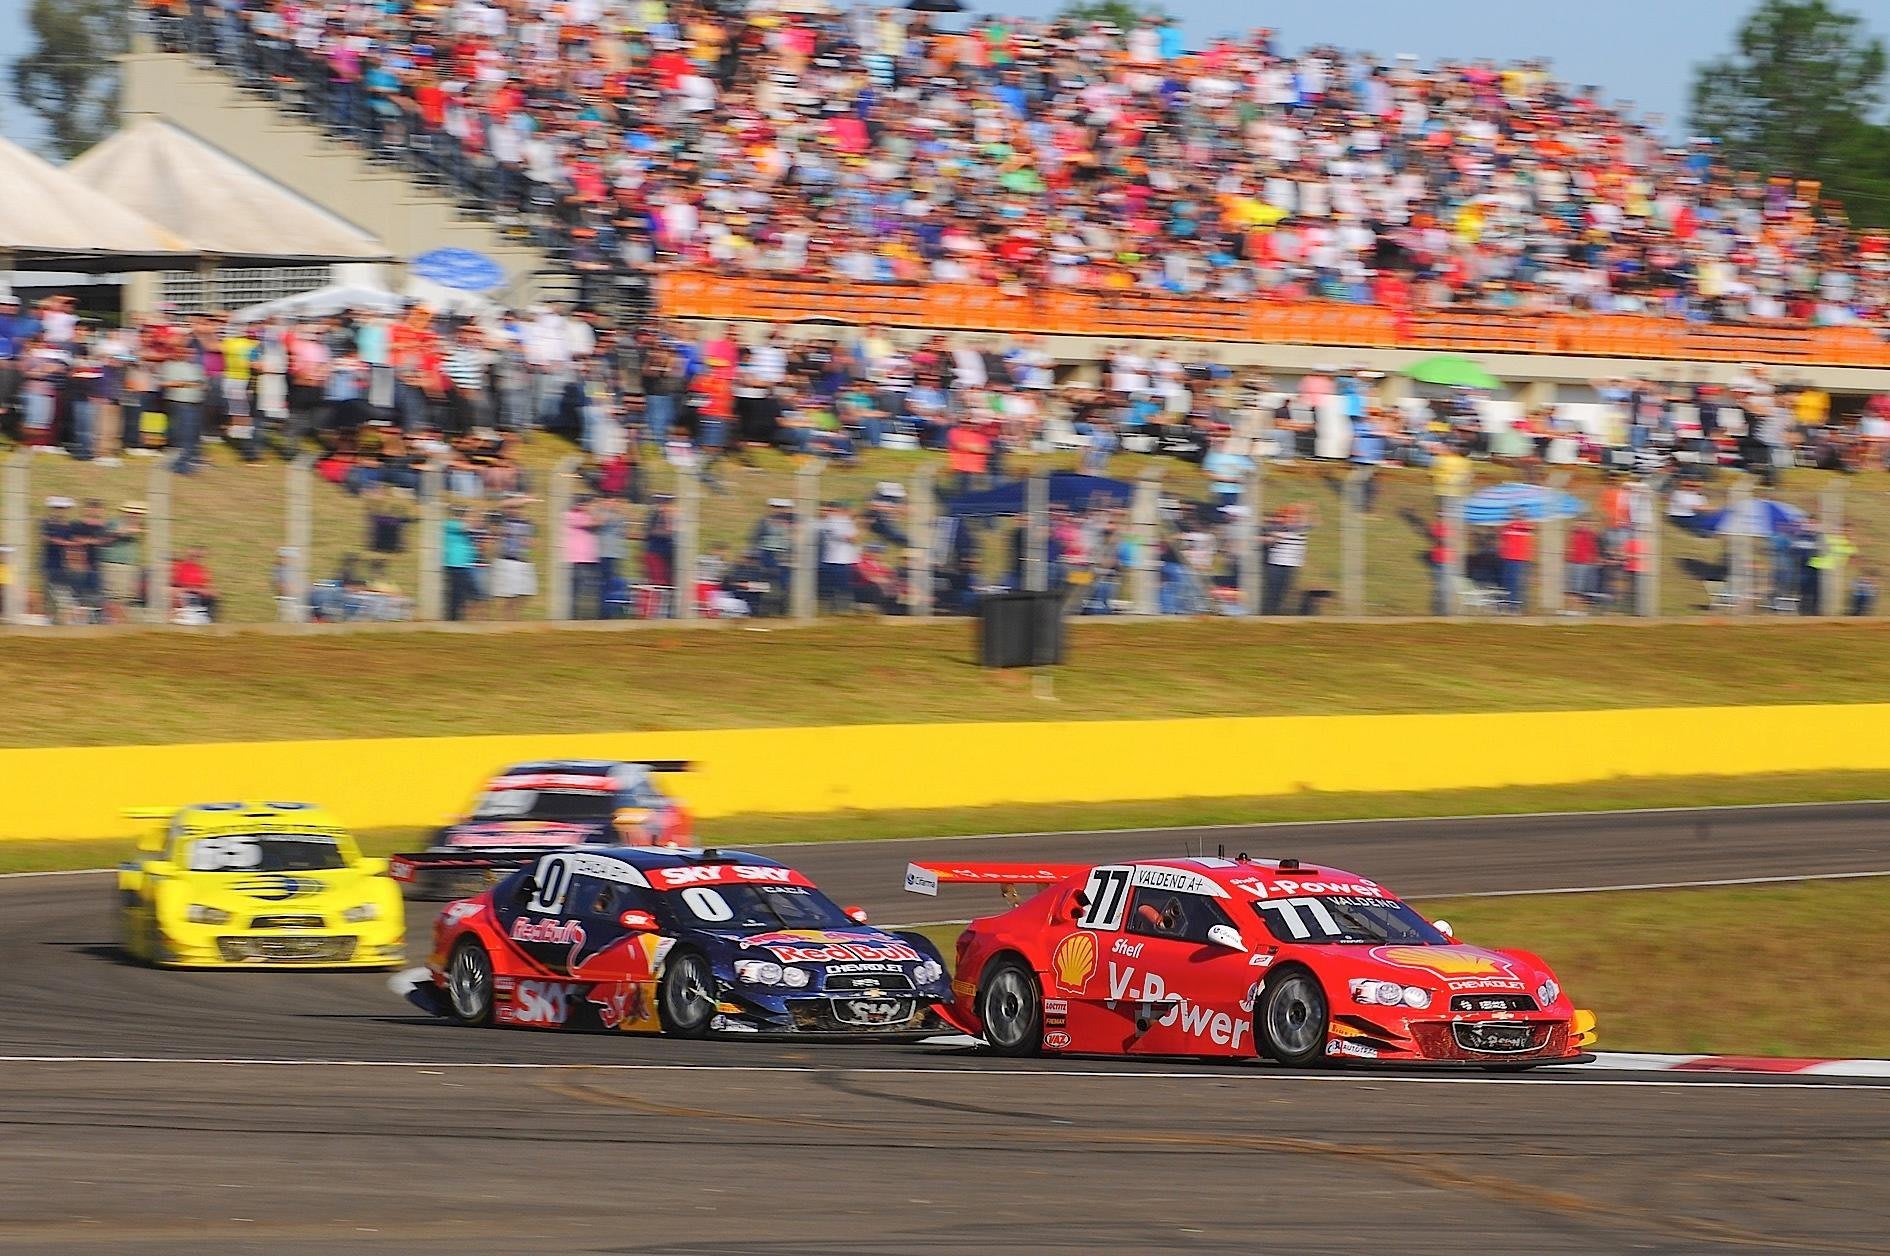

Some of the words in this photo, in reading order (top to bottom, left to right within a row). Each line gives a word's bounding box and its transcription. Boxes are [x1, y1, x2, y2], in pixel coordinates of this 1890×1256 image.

[660, 866, 722, 885] SKY
[731, 866, 790, 882] SKY
[1138, 869, 1187, 890] VALDENO
[1187, 876, 1204, 891] A+
[1093, 869, 1130, 925] 77
[1238, 879, 1383, 899] V-Power
[680, 887, 735, 922] 0
[1326, 896, 1402, 910] VALDENO
[1256, 896, 1343, 940] 77
[767, 944, 848, 962] Red
[846, 943, 921, 962] Bull
[1111, 938, 1145, 959] Shell
[825, 964, 904, 974] CHEVROLET
[1447, 981, 1526, 991] CHEVROLET
[512, 979, 570, 1023] SKY
[1108, 961, 1250, 1049] V-Power
